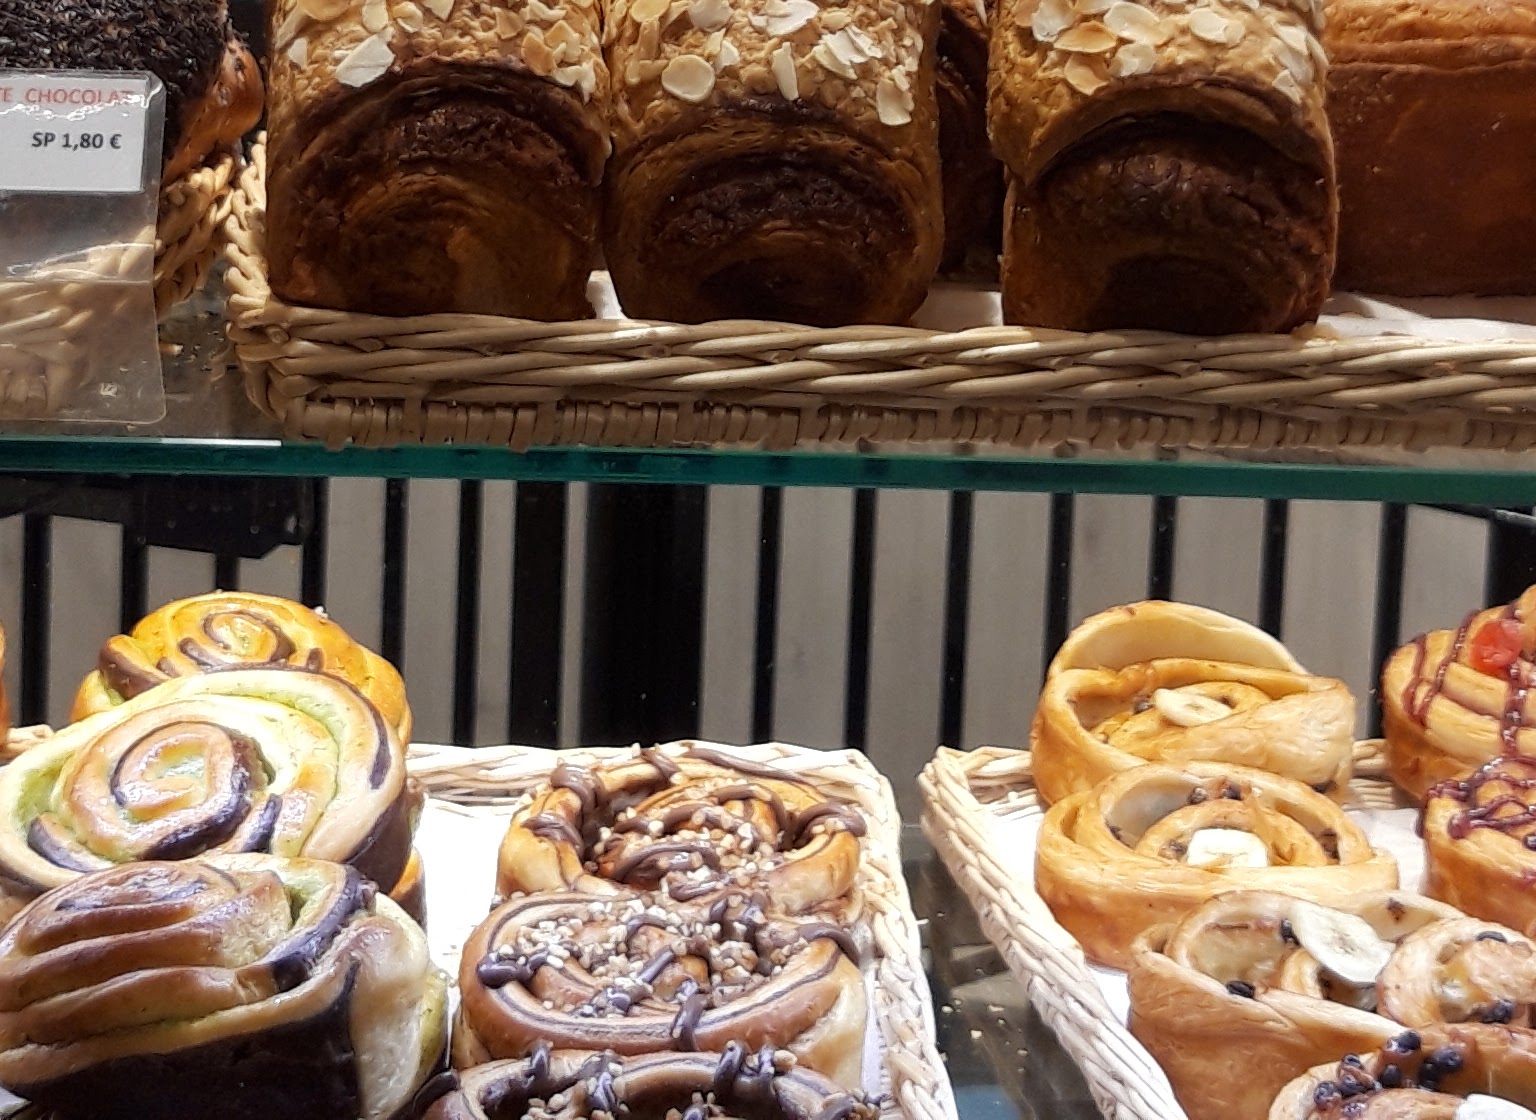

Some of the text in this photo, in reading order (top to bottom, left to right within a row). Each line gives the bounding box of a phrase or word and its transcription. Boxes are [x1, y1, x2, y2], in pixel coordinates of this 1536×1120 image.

[32, 133, 55, 148] SP
[62, 133, 103, 150] 1,80
[110, 133, 122, 149] €
